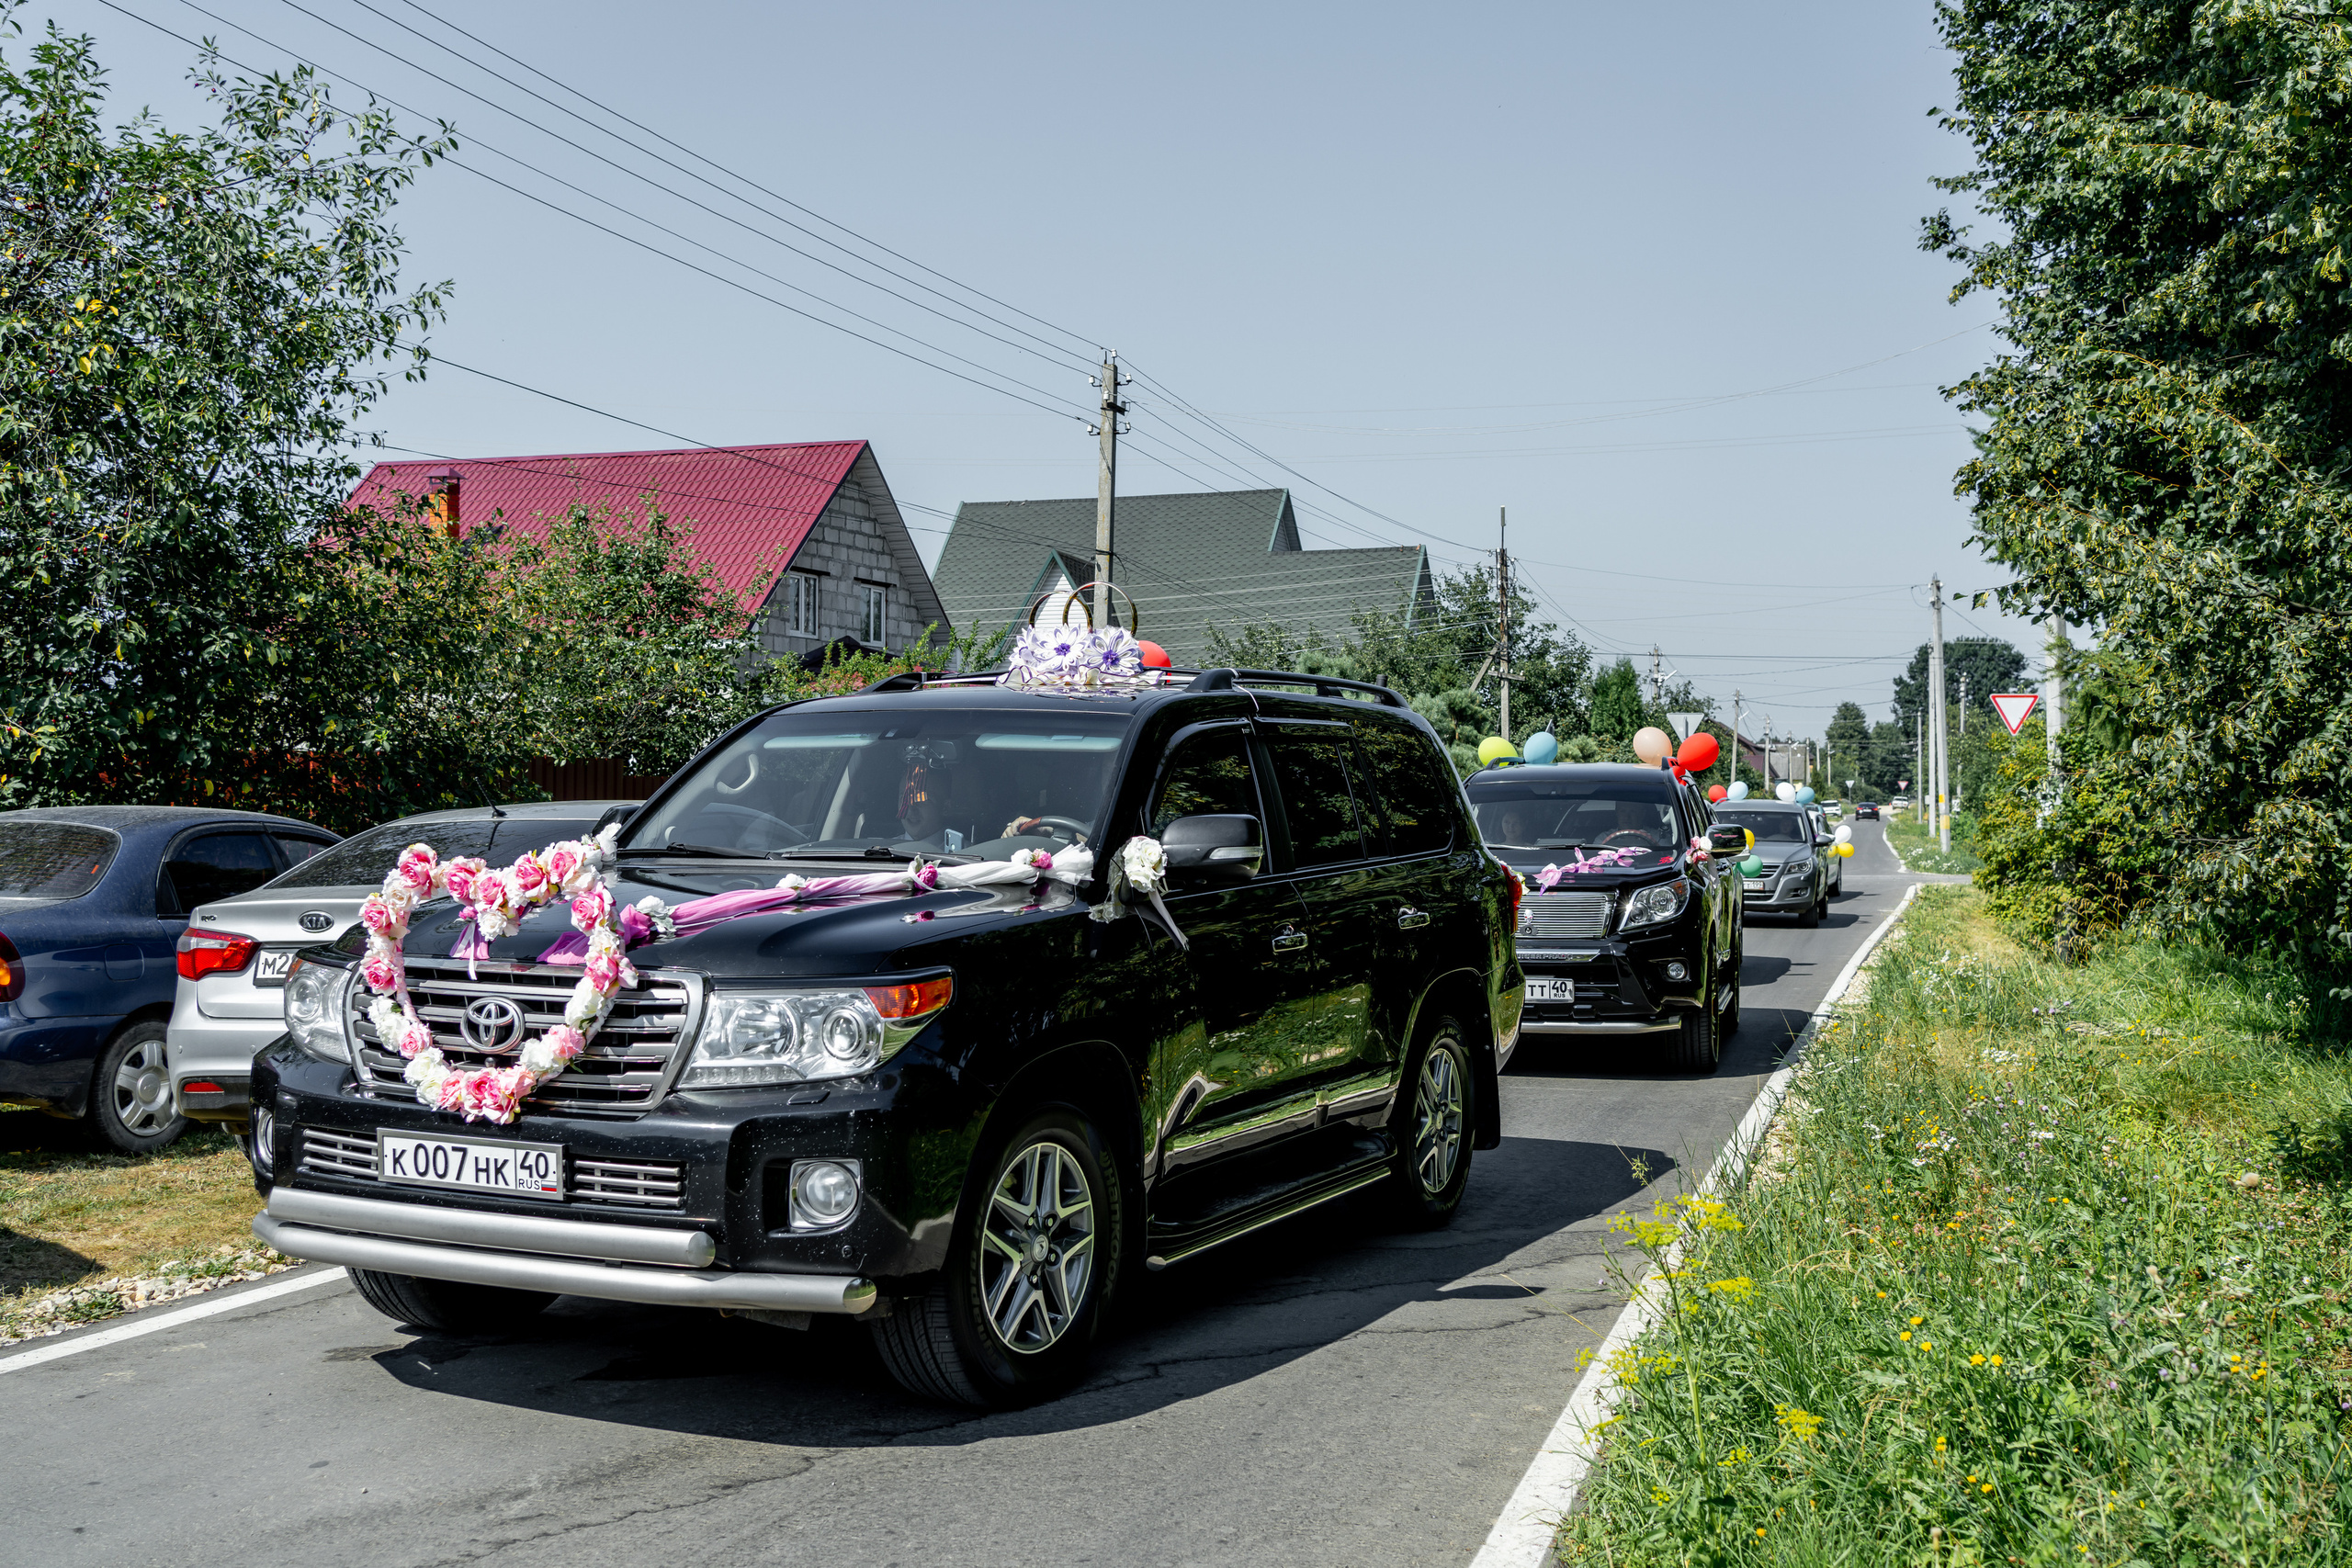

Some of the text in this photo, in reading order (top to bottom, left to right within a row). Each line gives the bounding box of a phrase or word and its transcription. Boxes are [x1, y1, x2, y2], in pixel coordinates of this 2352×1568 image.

[302, 916, 327, 928] KIA
[1552, 981, 1567, 993] 40
[519, 1151, 549, 1179] 40
[518, 1179, 540, 1190] RUS
